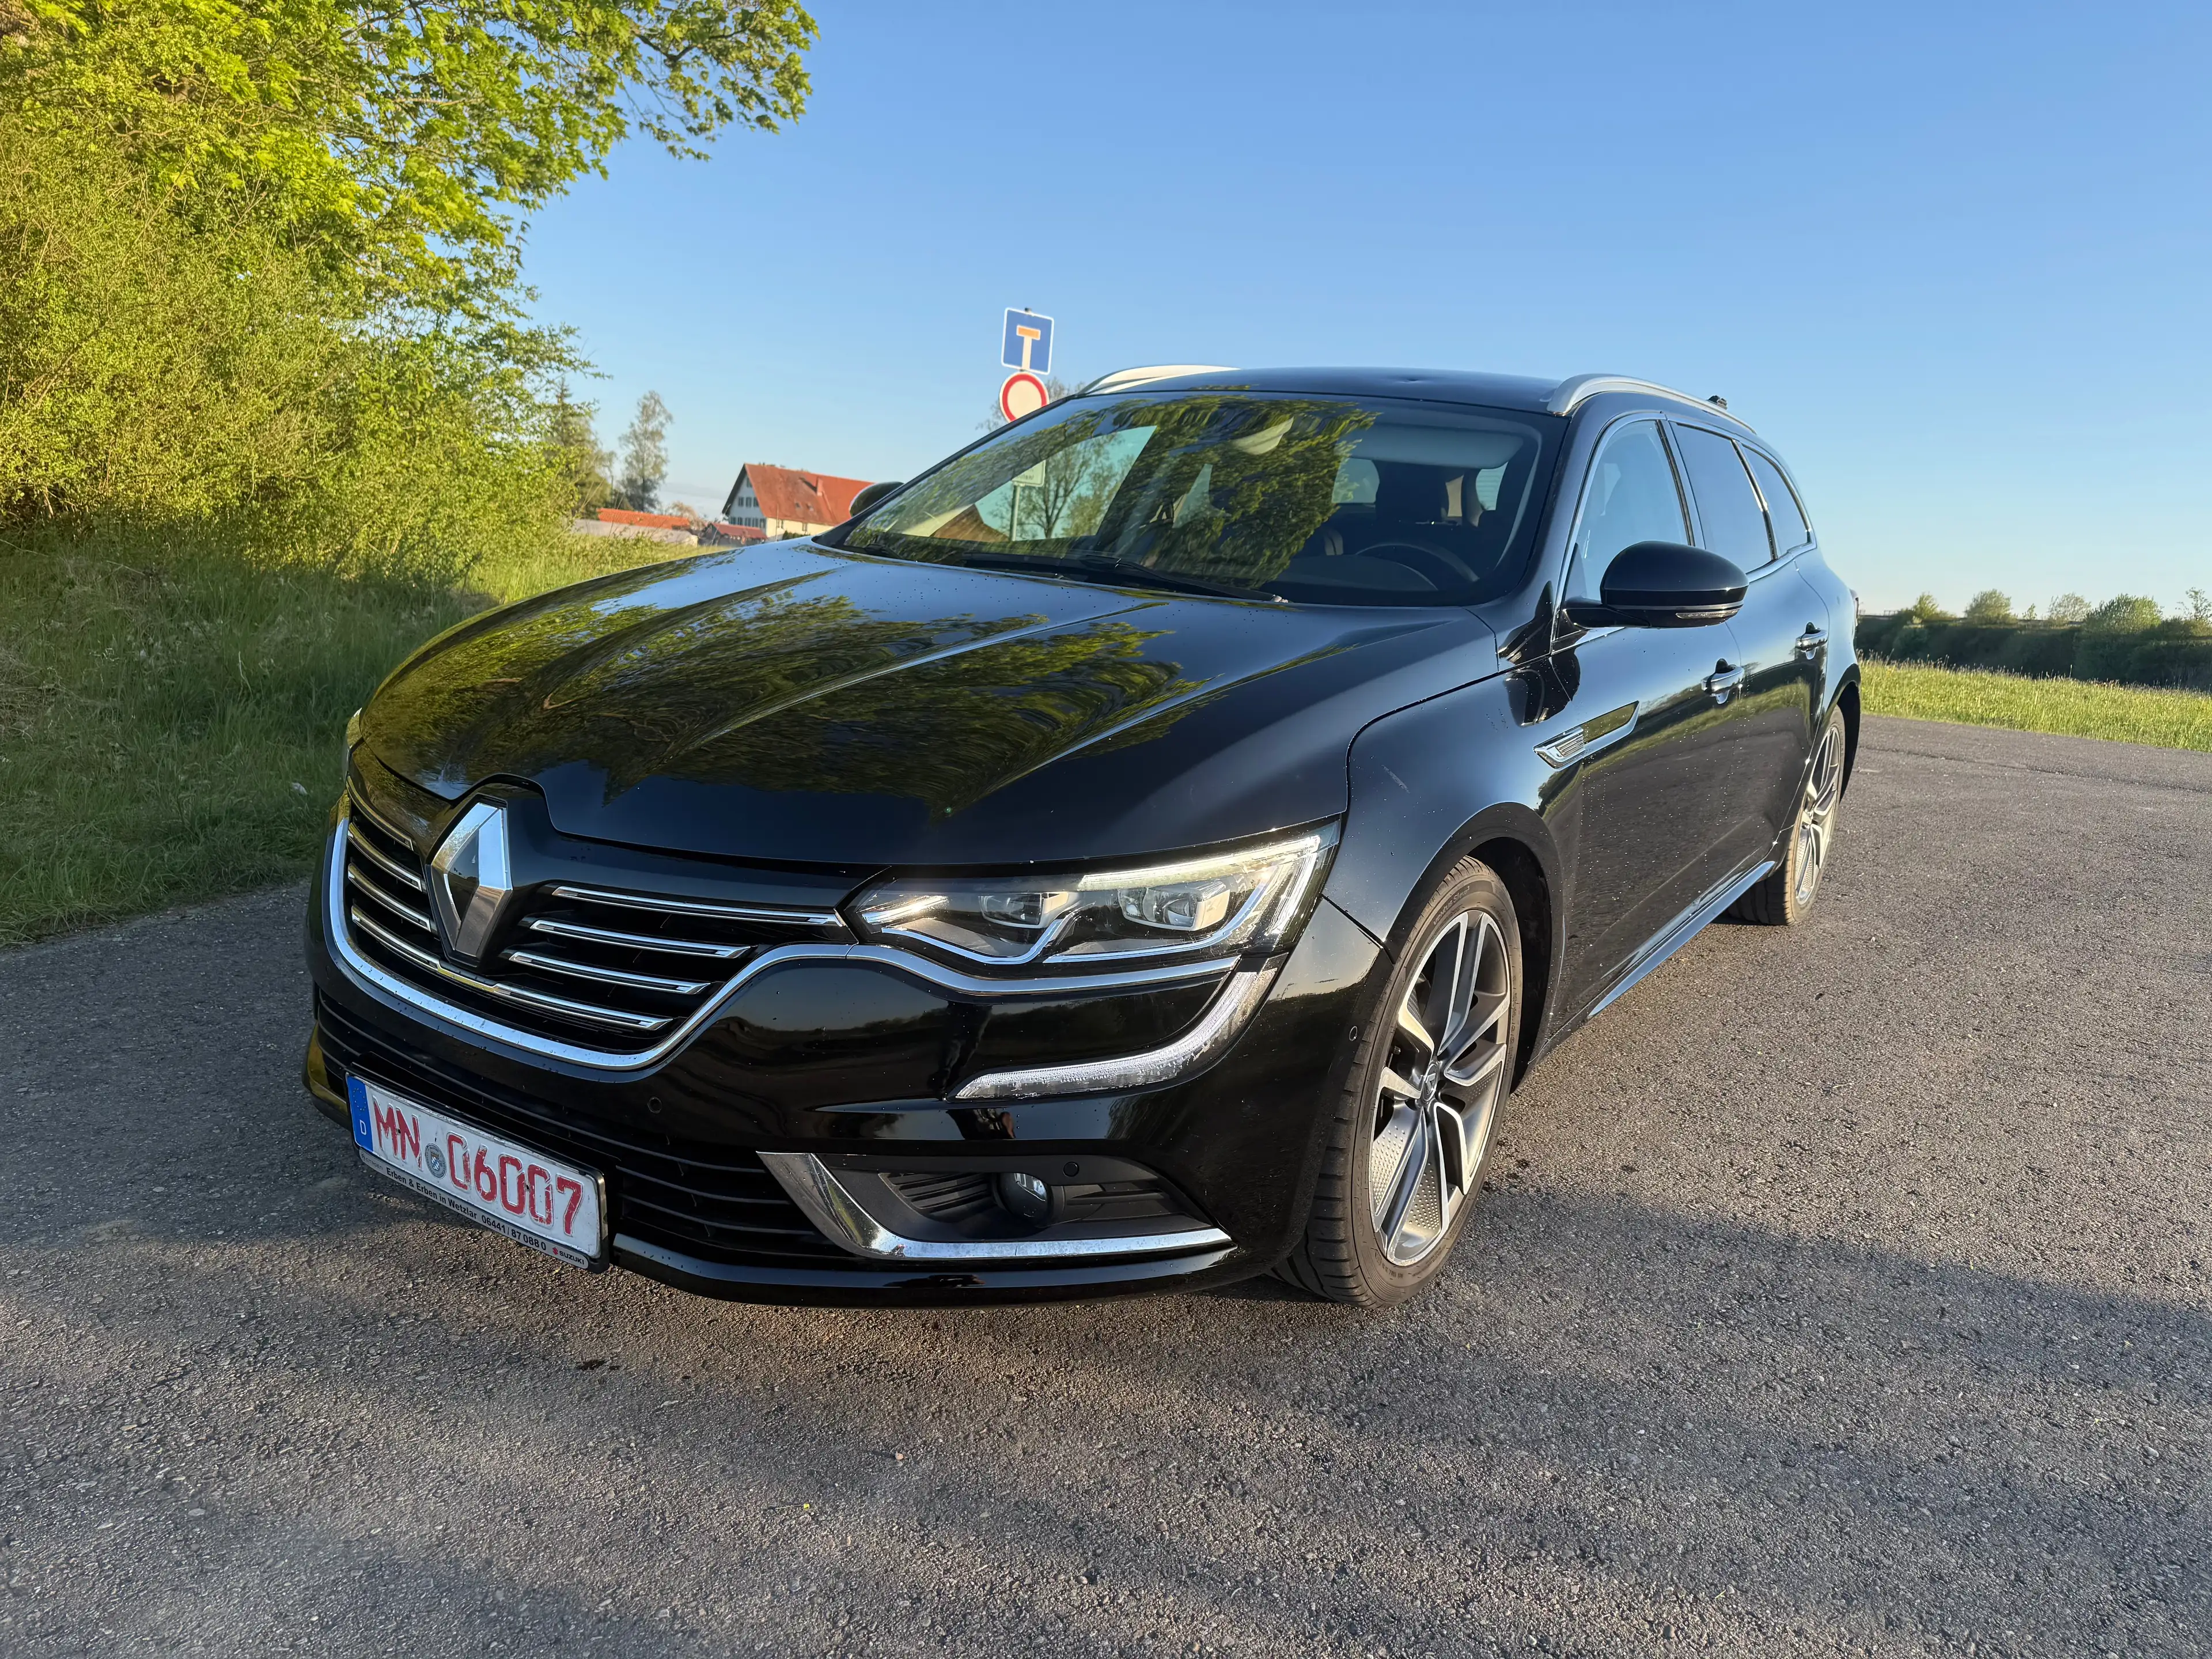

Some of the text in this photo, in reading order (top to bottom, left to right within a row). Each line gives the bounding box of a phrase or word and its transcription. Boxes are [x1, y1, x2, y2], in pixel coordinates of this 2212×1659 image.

[359, 1119, 367, 1135] D
[373, 1097, 583, 1235] MN 06007
[386, 1166, 407, 1184] Erben
[408, 1179, 415, 1188] &
[416, 1182, 438, 1200] Erben
[439, 1194, 446, 1204] in
[448, 1198, 478, 1219] Wetzlar
[559, 1251, 584, 1265] SUZUKI
